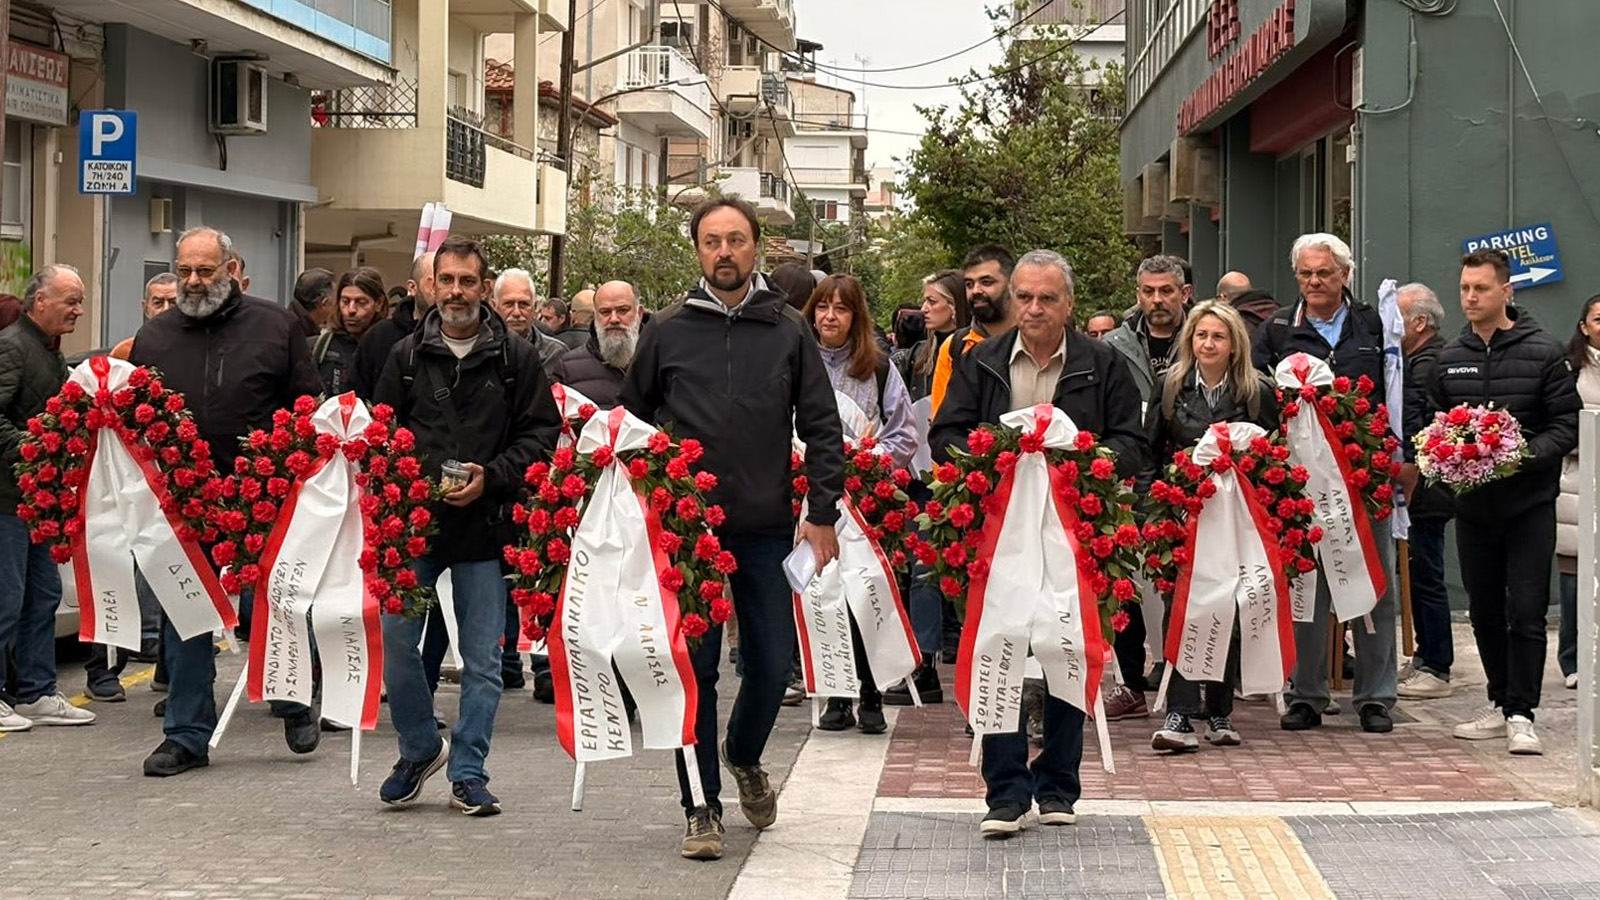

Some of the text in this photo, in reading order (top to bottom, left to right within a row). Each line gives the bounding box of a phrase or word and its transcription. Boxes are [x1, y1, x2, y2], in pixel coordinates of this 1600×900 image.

[7, 48, 63, 82] ΑΝΣΕΩΣ
[92, 114, 124, 156] P
[86, 181, 128, 191] ΖΩΝΗ Α
[87, 162, 128, 171] ΚΑΤΟΙΚΩΝ
[1467, 226, 1548, 254] PARKING
[1501, 244, 1535, 260] TEL
[1317, 490, 1337, 532] ΜΕΛΟΣ
[1239, 565, 1257, 610] ΜΕΛΟΣ
[567, 550, 597, 751] ΕΡΓΑΤΟΥΠΑΛΛΗΛΙΚΟ
[810, 578, 837, 689] ΕΝΩΣΗ ΓΟΝΕΩΝ
[1183, 623, 1199, 674] ΕΝΩΣΗ
[1202, 612, 1222, 676] ΓΥΝΑΙΚΩΝ
[266, 626, 283, 695] ΣΥΝΔΙΚΑΤΟ
[597, 672, 626, 752] ΚΕΝΤΡΟ
[976, 654, 992, 728] ΣΩΜΑΤΕΙΟ
[1008, 685, 1021, 711] ΙΚΑ
